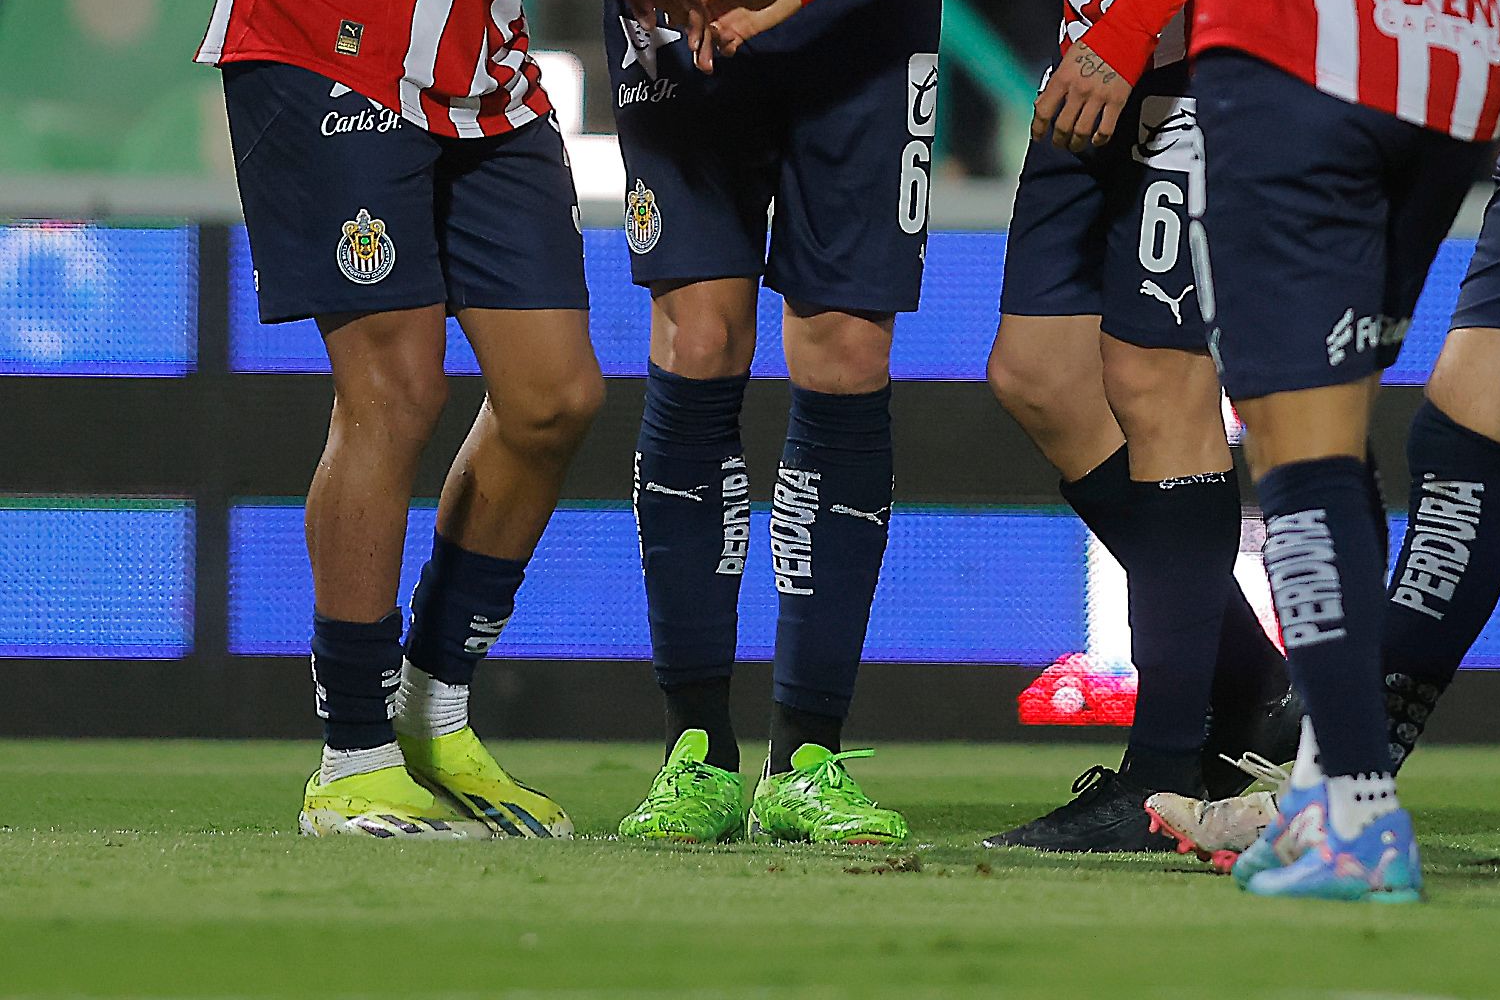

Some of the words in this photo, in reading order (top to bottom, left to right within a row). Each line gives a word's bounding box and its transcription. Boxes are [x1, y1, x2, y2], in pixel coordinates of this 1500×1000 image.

[320, 108, 376, 136] Carl's
[376, 108, 402, 133] Jr.
[619, 78, 649, 108] Carl's
[899, 140, 930, 234] 6
[1138, 180, 1184, 273] 6
[769, 464, 822, 596] PERDURA
[1391, 475, 1486, 620] PERDURA
